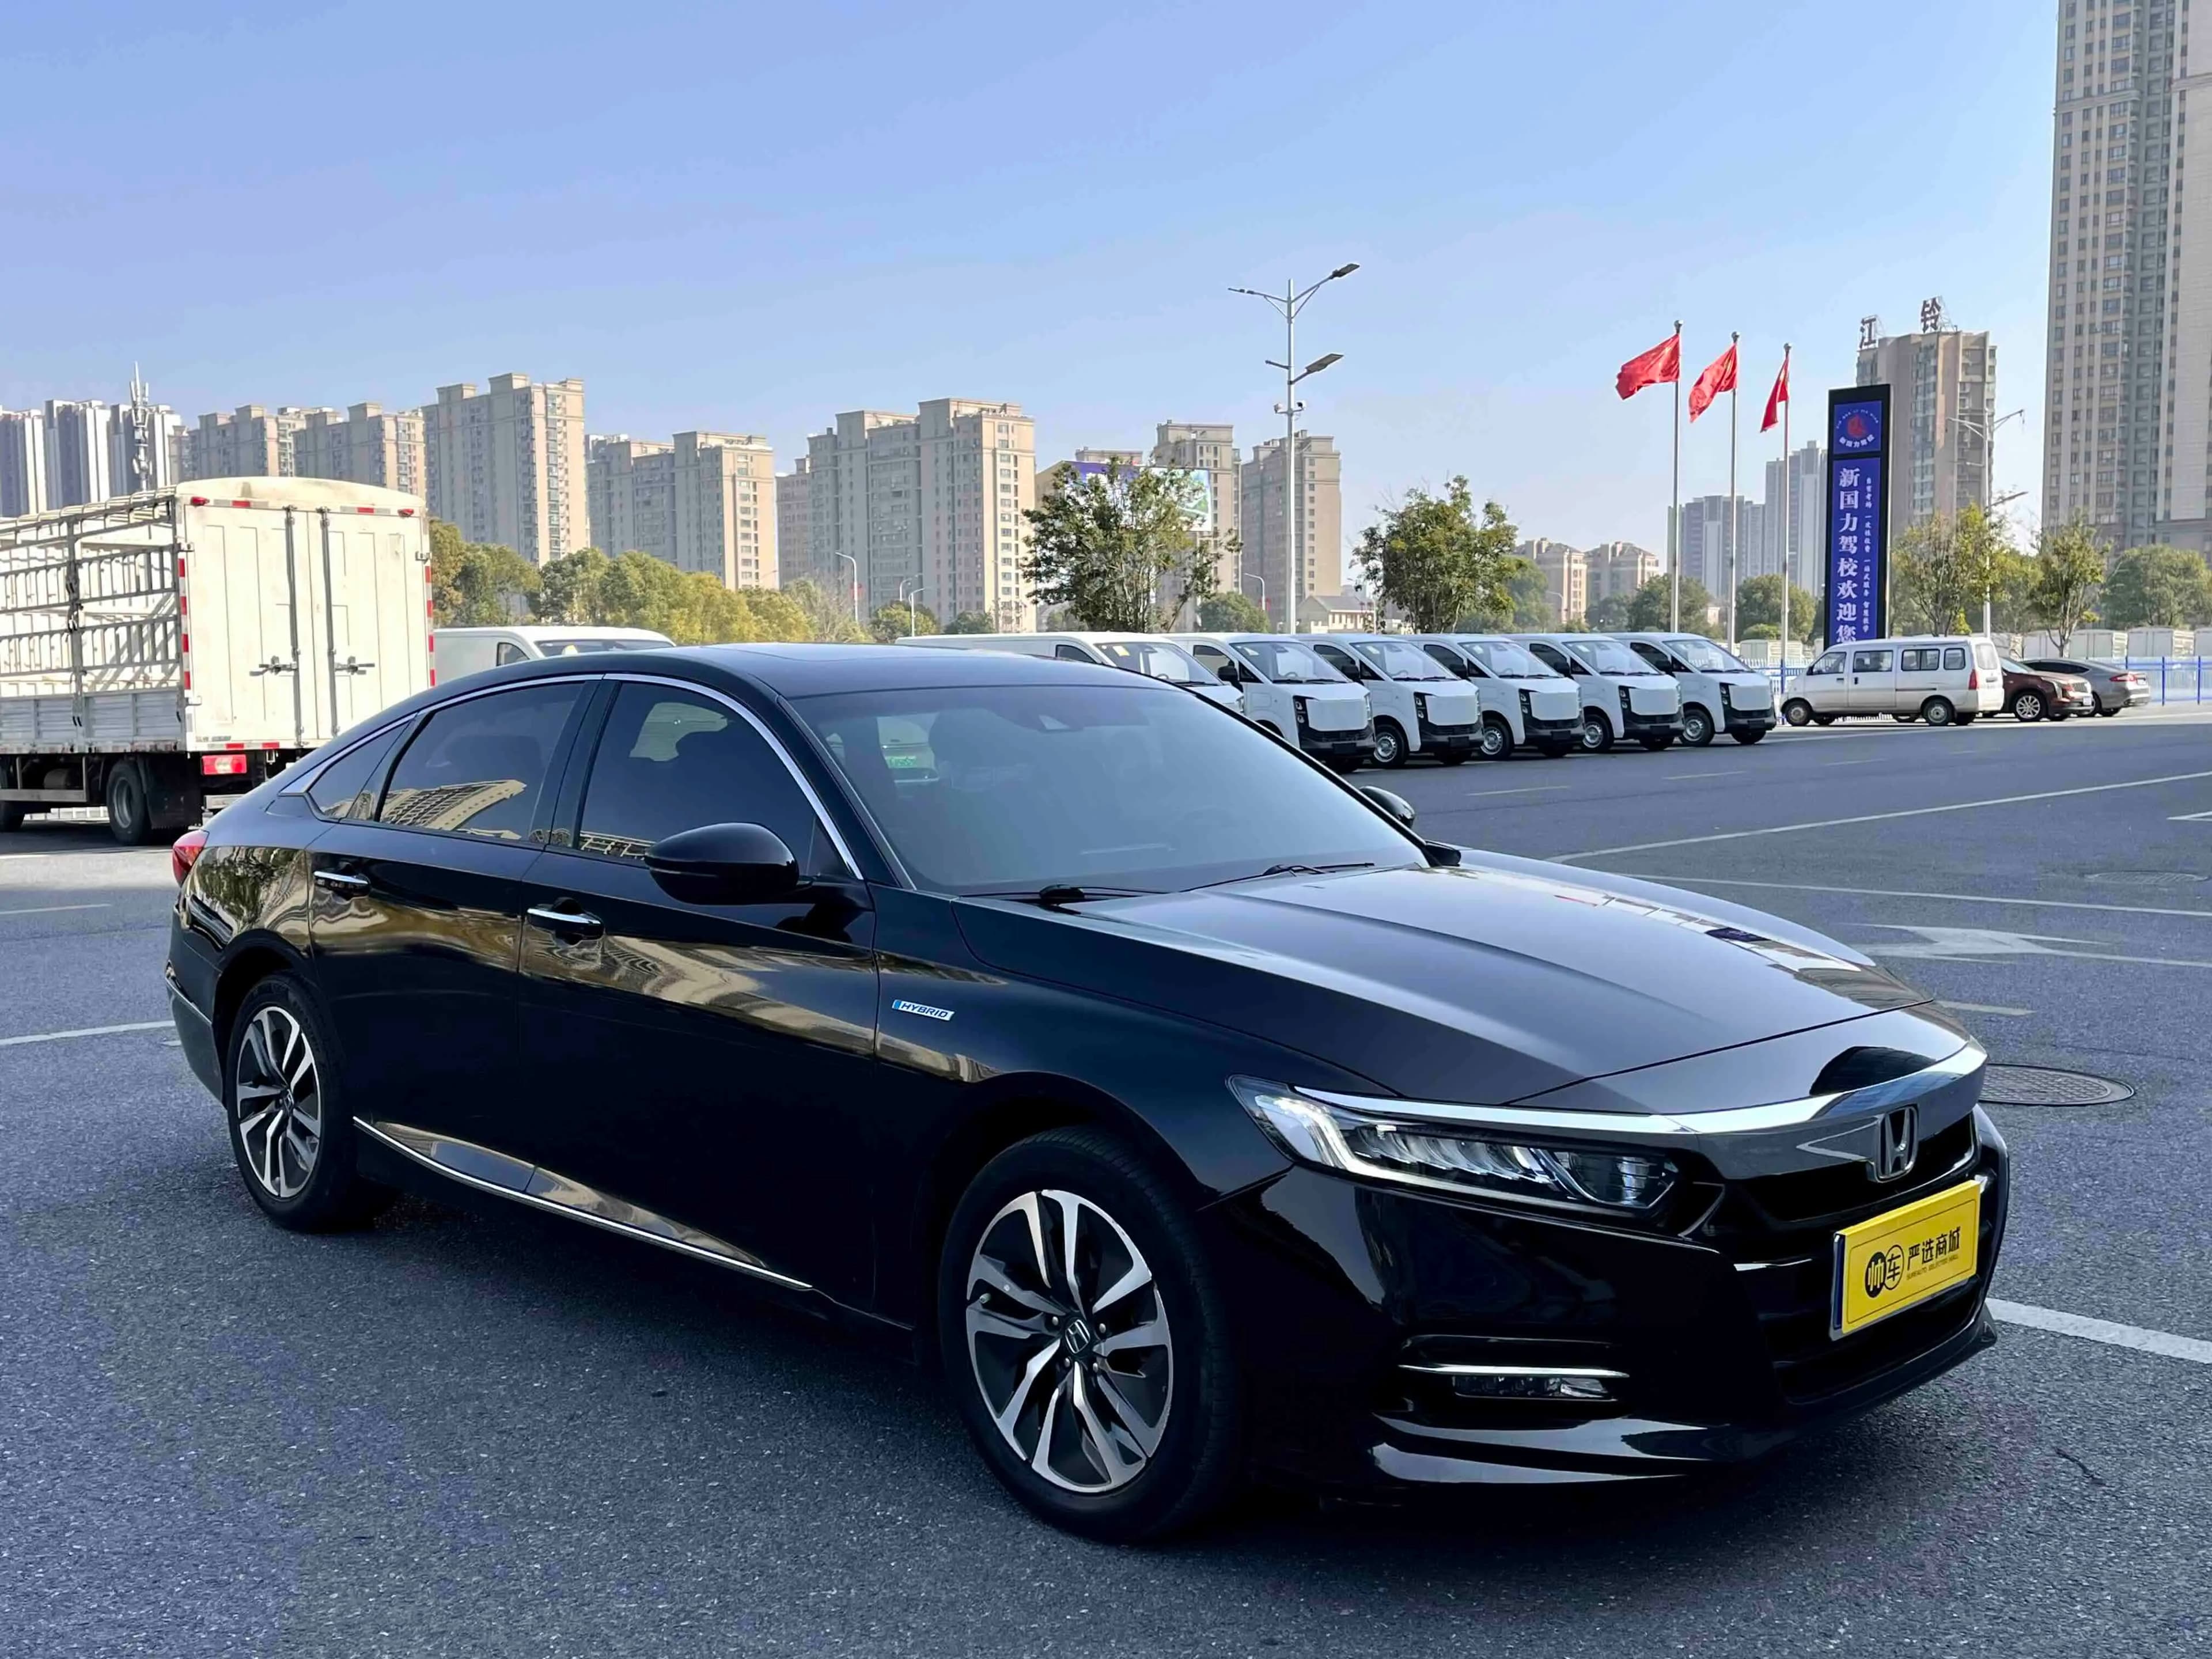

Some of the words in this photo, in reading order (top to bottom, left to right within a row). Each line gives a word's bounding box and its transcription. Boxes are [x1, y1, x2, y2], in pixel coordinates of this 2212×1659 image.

[1859, 297, 1941, 349] 江铃
[1836, 468, 1860, 643] 新国力驾校欢迎您
[901, 1002, 948, 1018] HYBRID
[1866, 1251, 1902, 1293] 帅车
[1907, 1226, 1960, 1271] 严选商城
